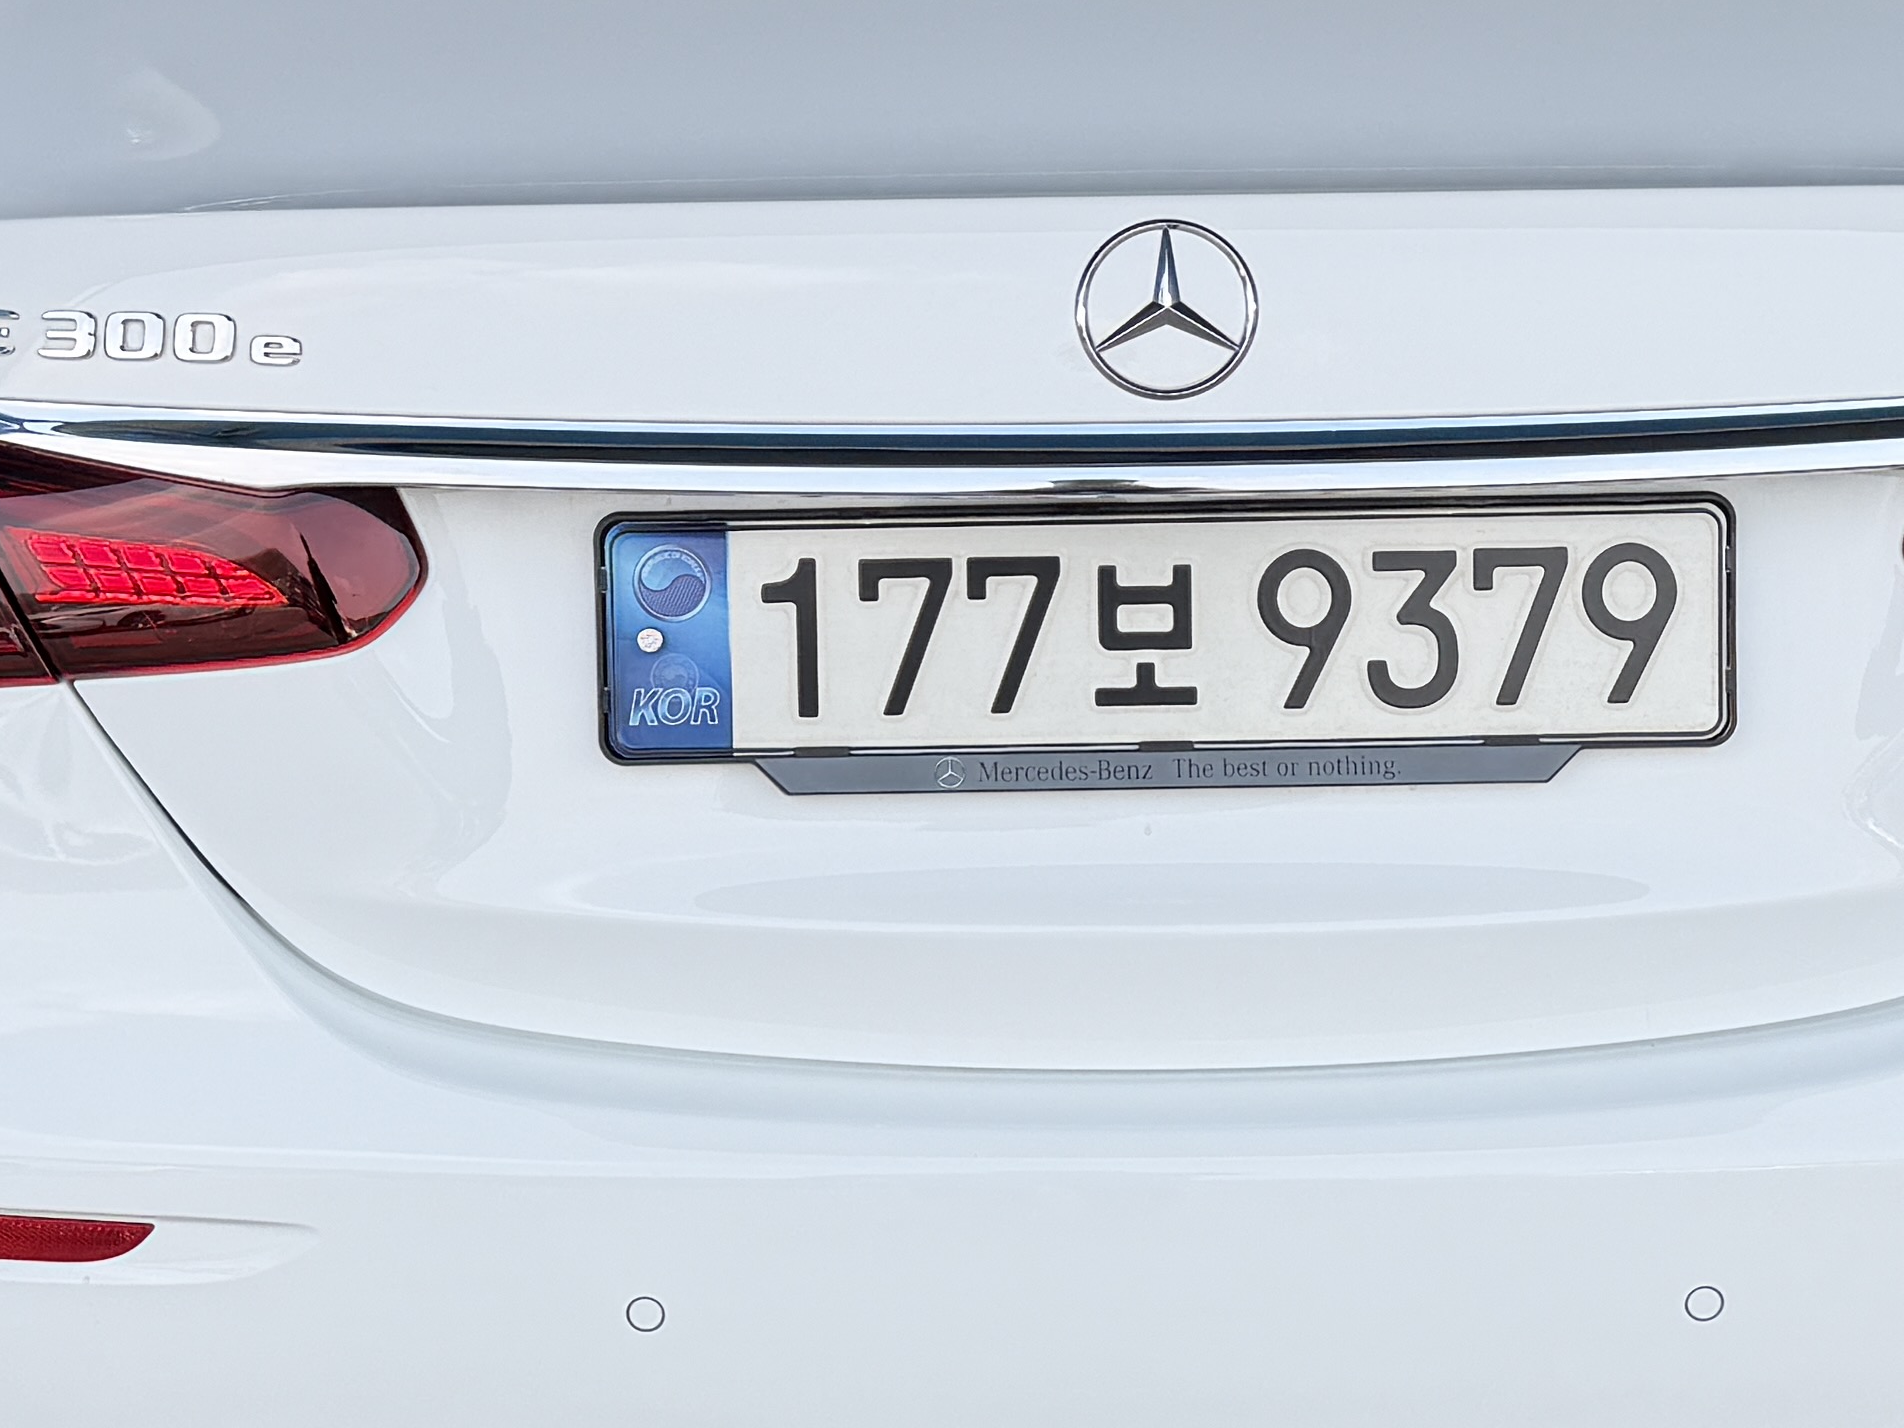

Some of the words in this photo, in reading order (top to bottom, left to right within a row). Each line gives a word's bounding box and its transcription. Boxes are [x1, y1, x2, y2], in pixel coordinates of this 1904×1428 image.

[1257, 542, 1678, 710] 9379
[629, 686, 721, 726] KOR
[979, 760, 1153, 782] Mercedes-Benz
[1173, 758, 1214, 779] The
[1223, 758, 1268, 778] best
[1277, 761, 1296, 778] or
[1308, 756, 1402, 780] nothing.
